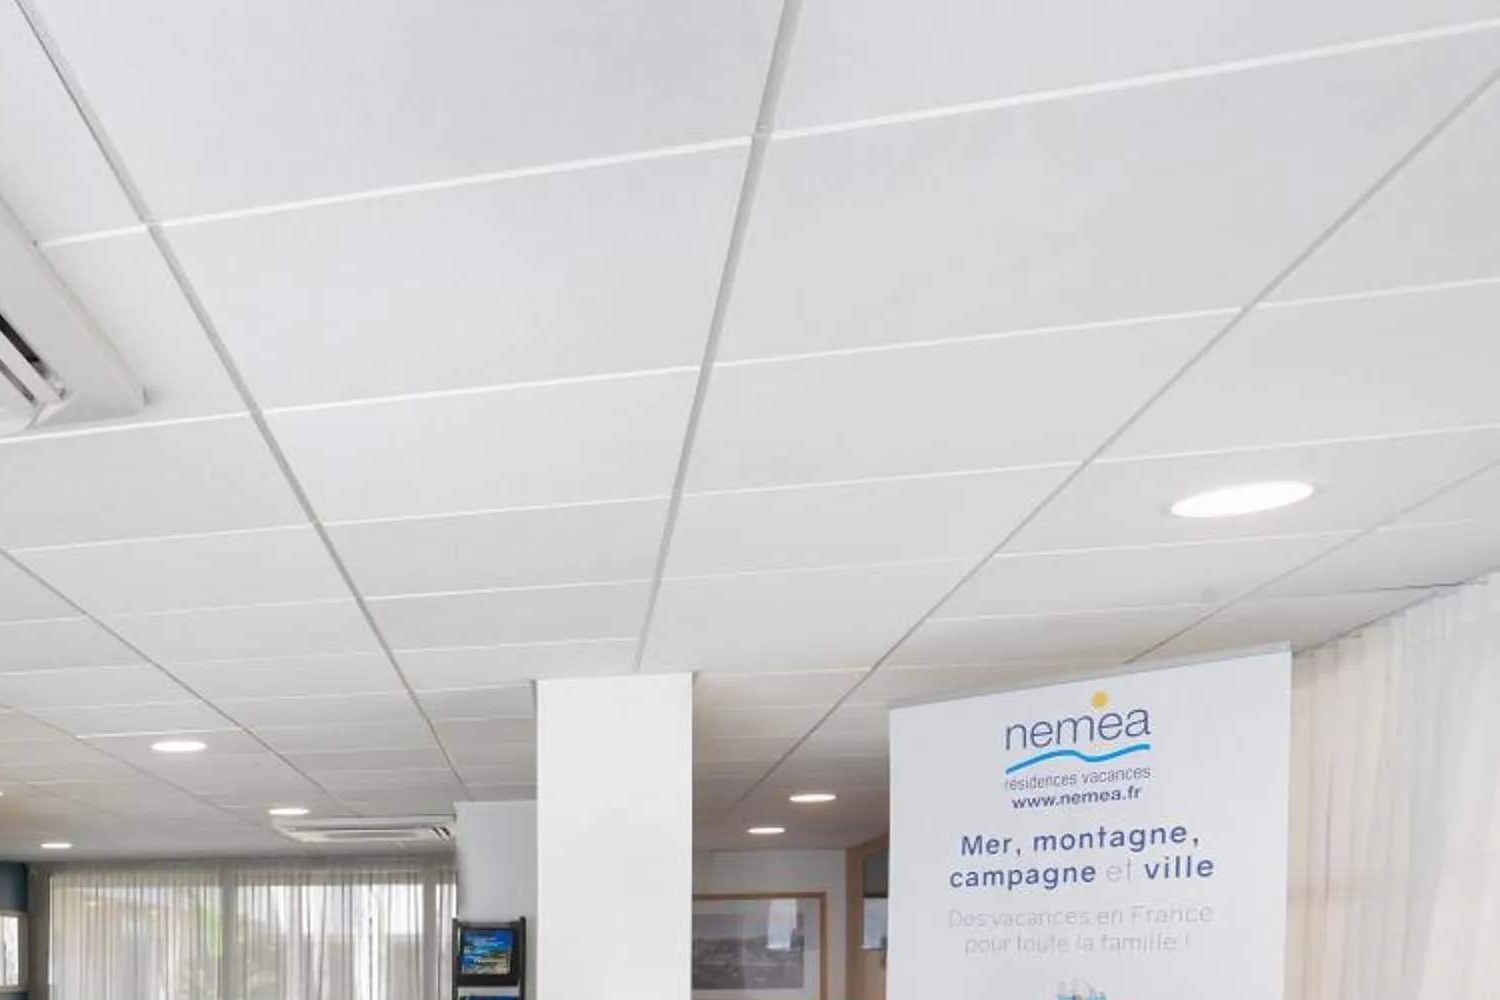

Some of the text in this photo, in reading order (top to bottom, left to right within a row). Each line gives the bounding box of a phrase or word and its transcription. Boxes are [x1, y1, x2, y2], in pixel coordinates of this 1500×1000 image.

[1081, 766, 1152, 785] vacances
[1011, 785, 1143, 809] www.nemea.fr
[961, 825, 1200, 858] Mer, montagne,
[949, 855, 1215, 891] campagne et ville
[991, 908, 1091, 928] vacances
[1096, 908, 1124, 926] en
[1130, 904, 1215, 924] France
[964, 936, 1011, 957] pour
[1016, 934, 1071, 954] toute
[1076, 933, 1094, 952] la
[1100, 932, 1177, 952] famille
